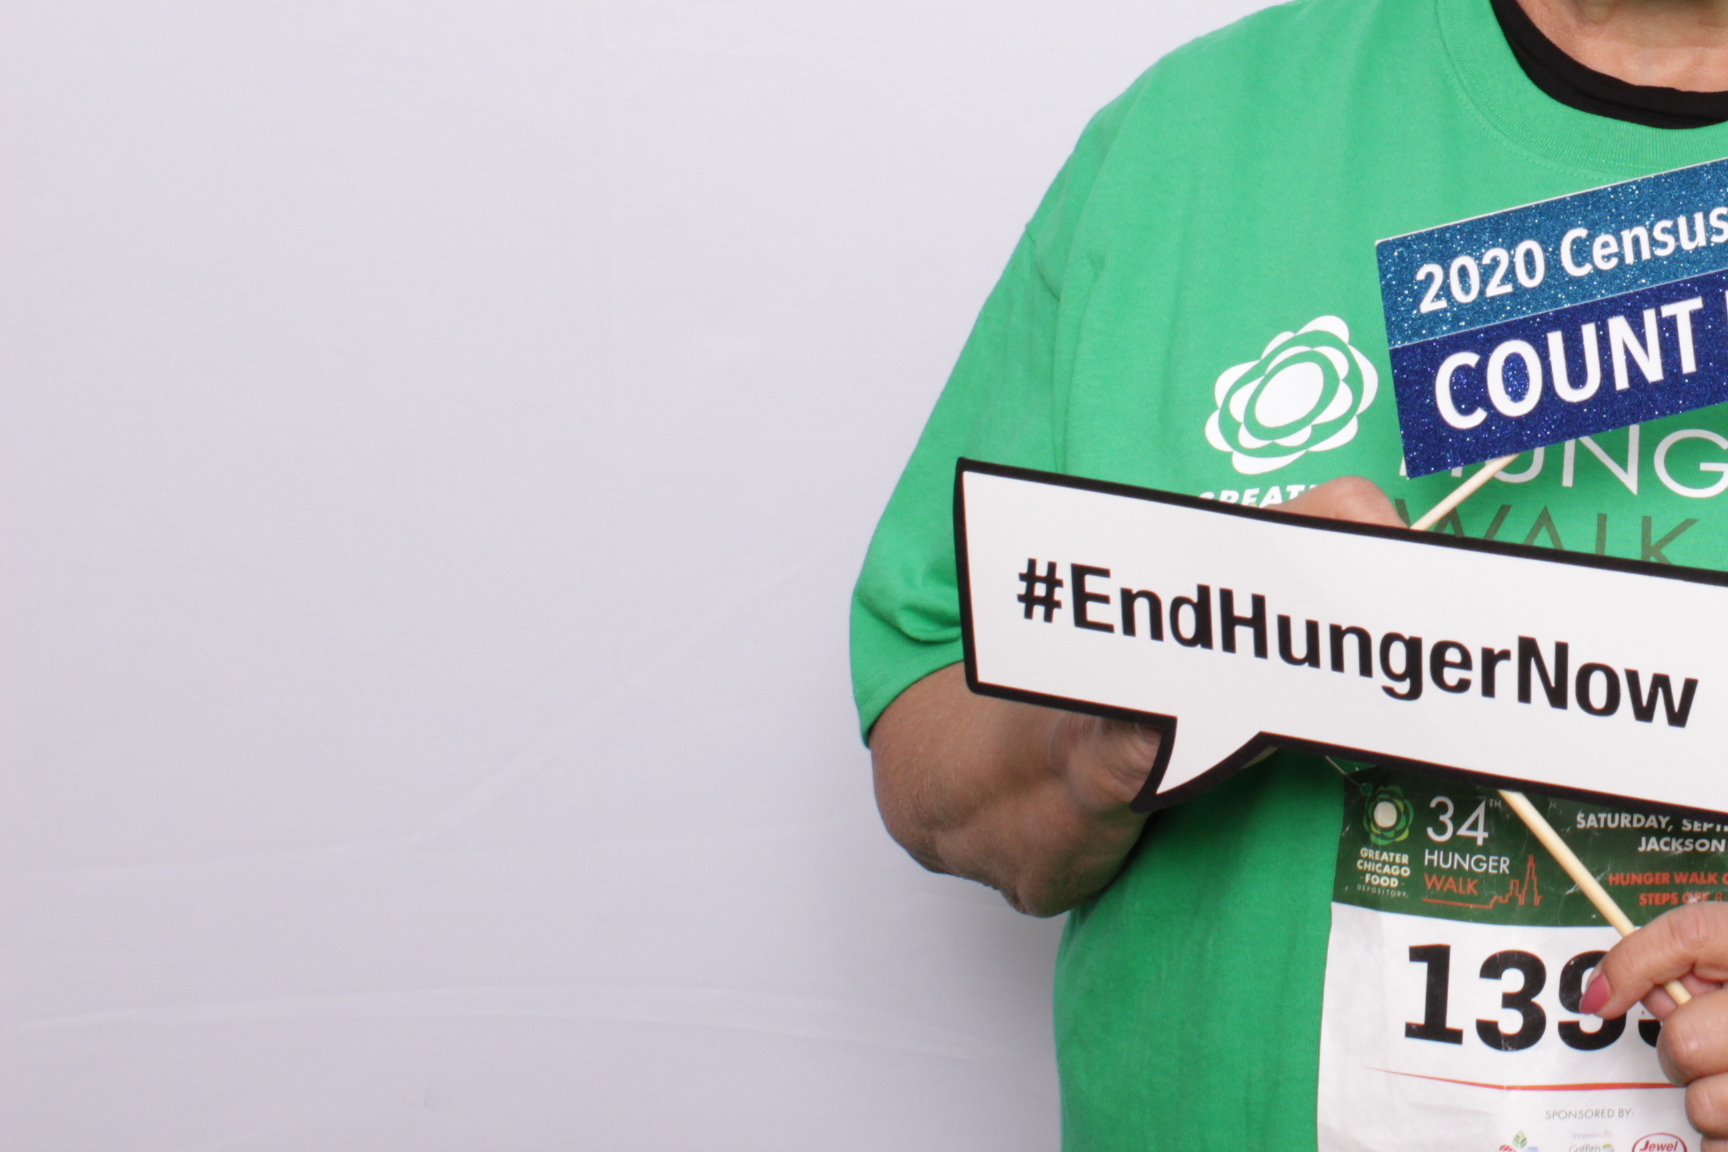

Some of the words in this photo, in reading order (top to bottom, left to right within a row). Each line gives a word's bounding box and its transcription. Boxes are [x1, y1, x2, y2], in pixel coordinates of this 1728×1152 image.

[1414, 239, 1546, 314] 2020
[1434, 297, 1703, 431] COUNT
[1017, 557, 1699, 729] #EndHungerNow
[1576, 813, 1674, 832] SATURDAY,
[1638, 836, 1726, 852] JACKSON
[1360, 848, 1409, 865] GREATER
[1424, 849, 1510, 874] HUNGER
[1357, 859, 1411, 878] CHICAGO
[1365, 875, 1399, 888] FOOD
[1424, 873, 1479, 895] WALK
[1608, 872, 1671, 886] HUNGER
[1674, 872, 1719, 886] WALK
[1639, 892, 1679, 906] STEPS
[1545, 1109, 1615, 1120] SPONSORED
[1618, 1108, 1635, 1118] BY:
[1639, 1139, 1679, 1152] Jewel
